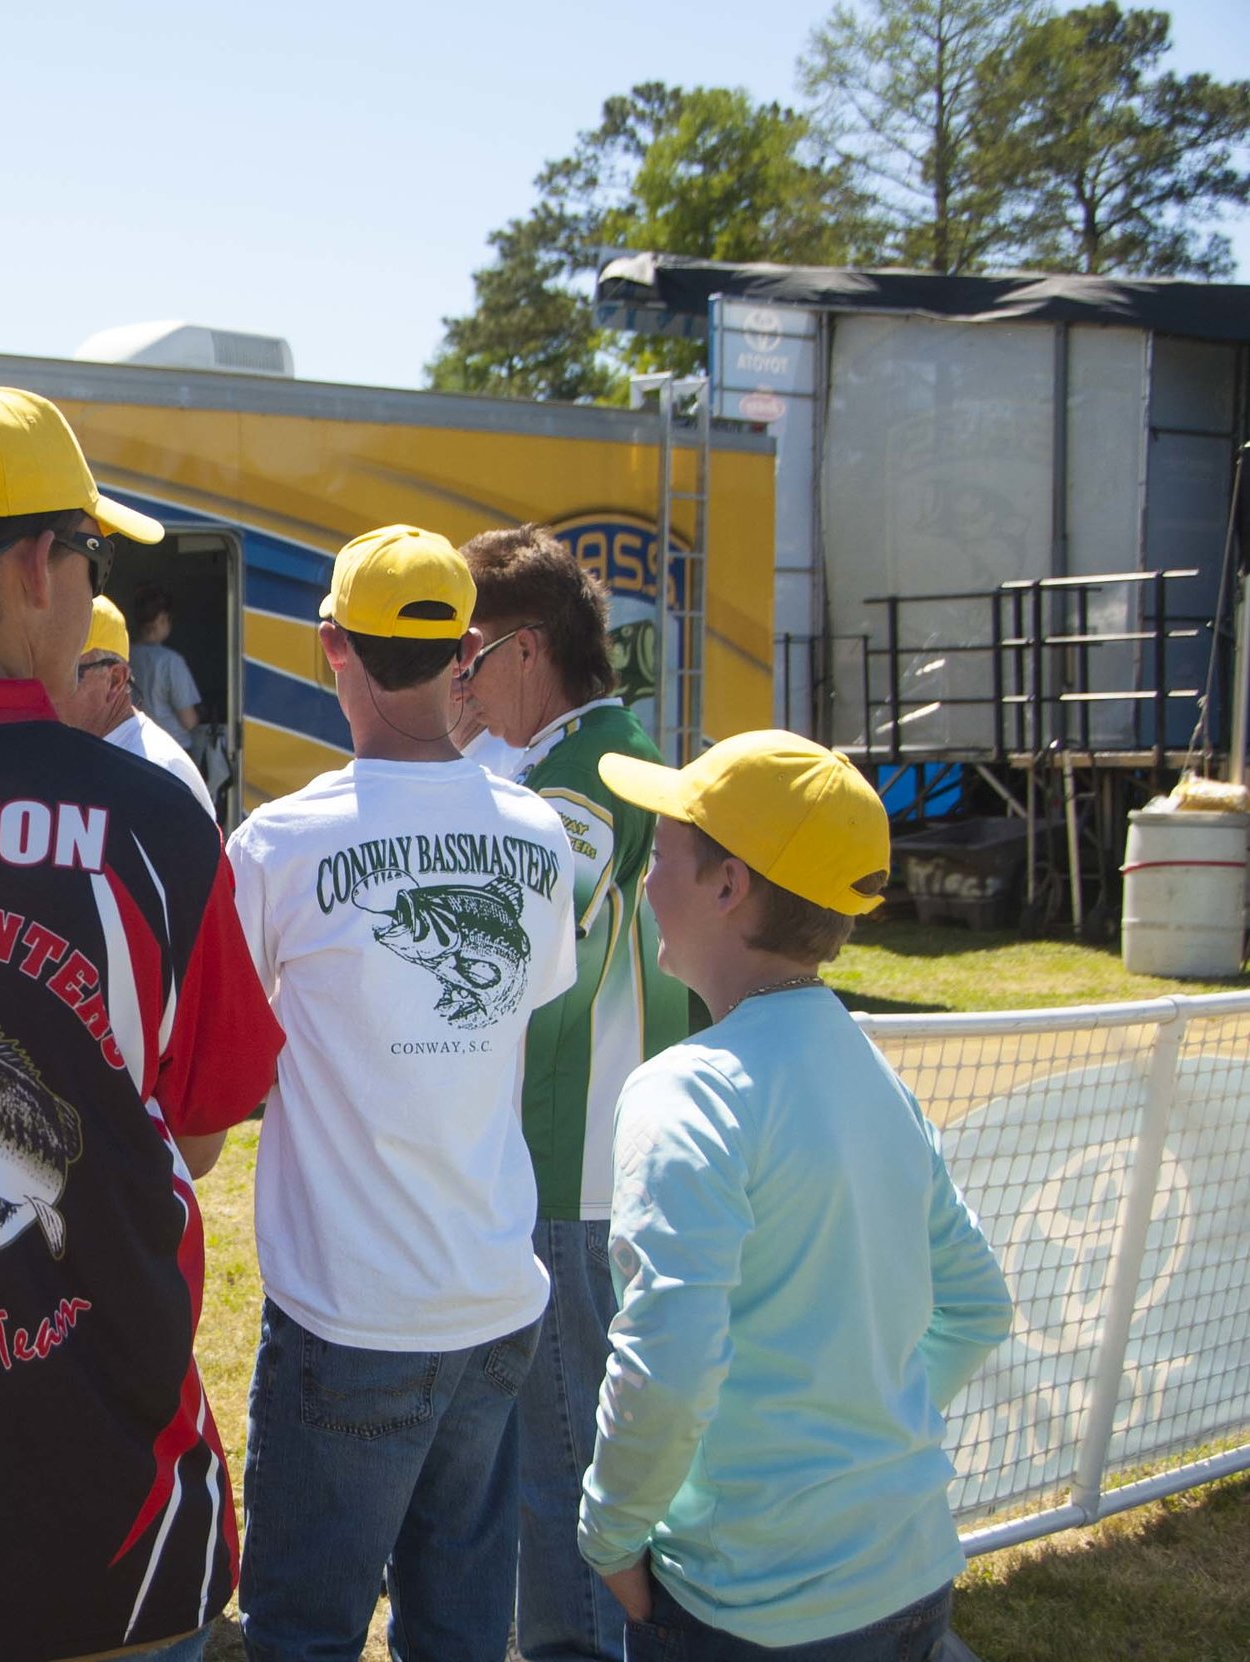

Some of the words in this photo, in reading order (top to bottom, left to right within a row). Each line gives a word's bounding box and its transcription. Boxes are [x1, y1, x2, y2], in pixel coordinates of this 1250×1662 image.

[316, 835, 413, 915] CONWAY
[391, 1040, 466, 1055] CONWAY,
[468, 1039, 493, 1053] S.C.
